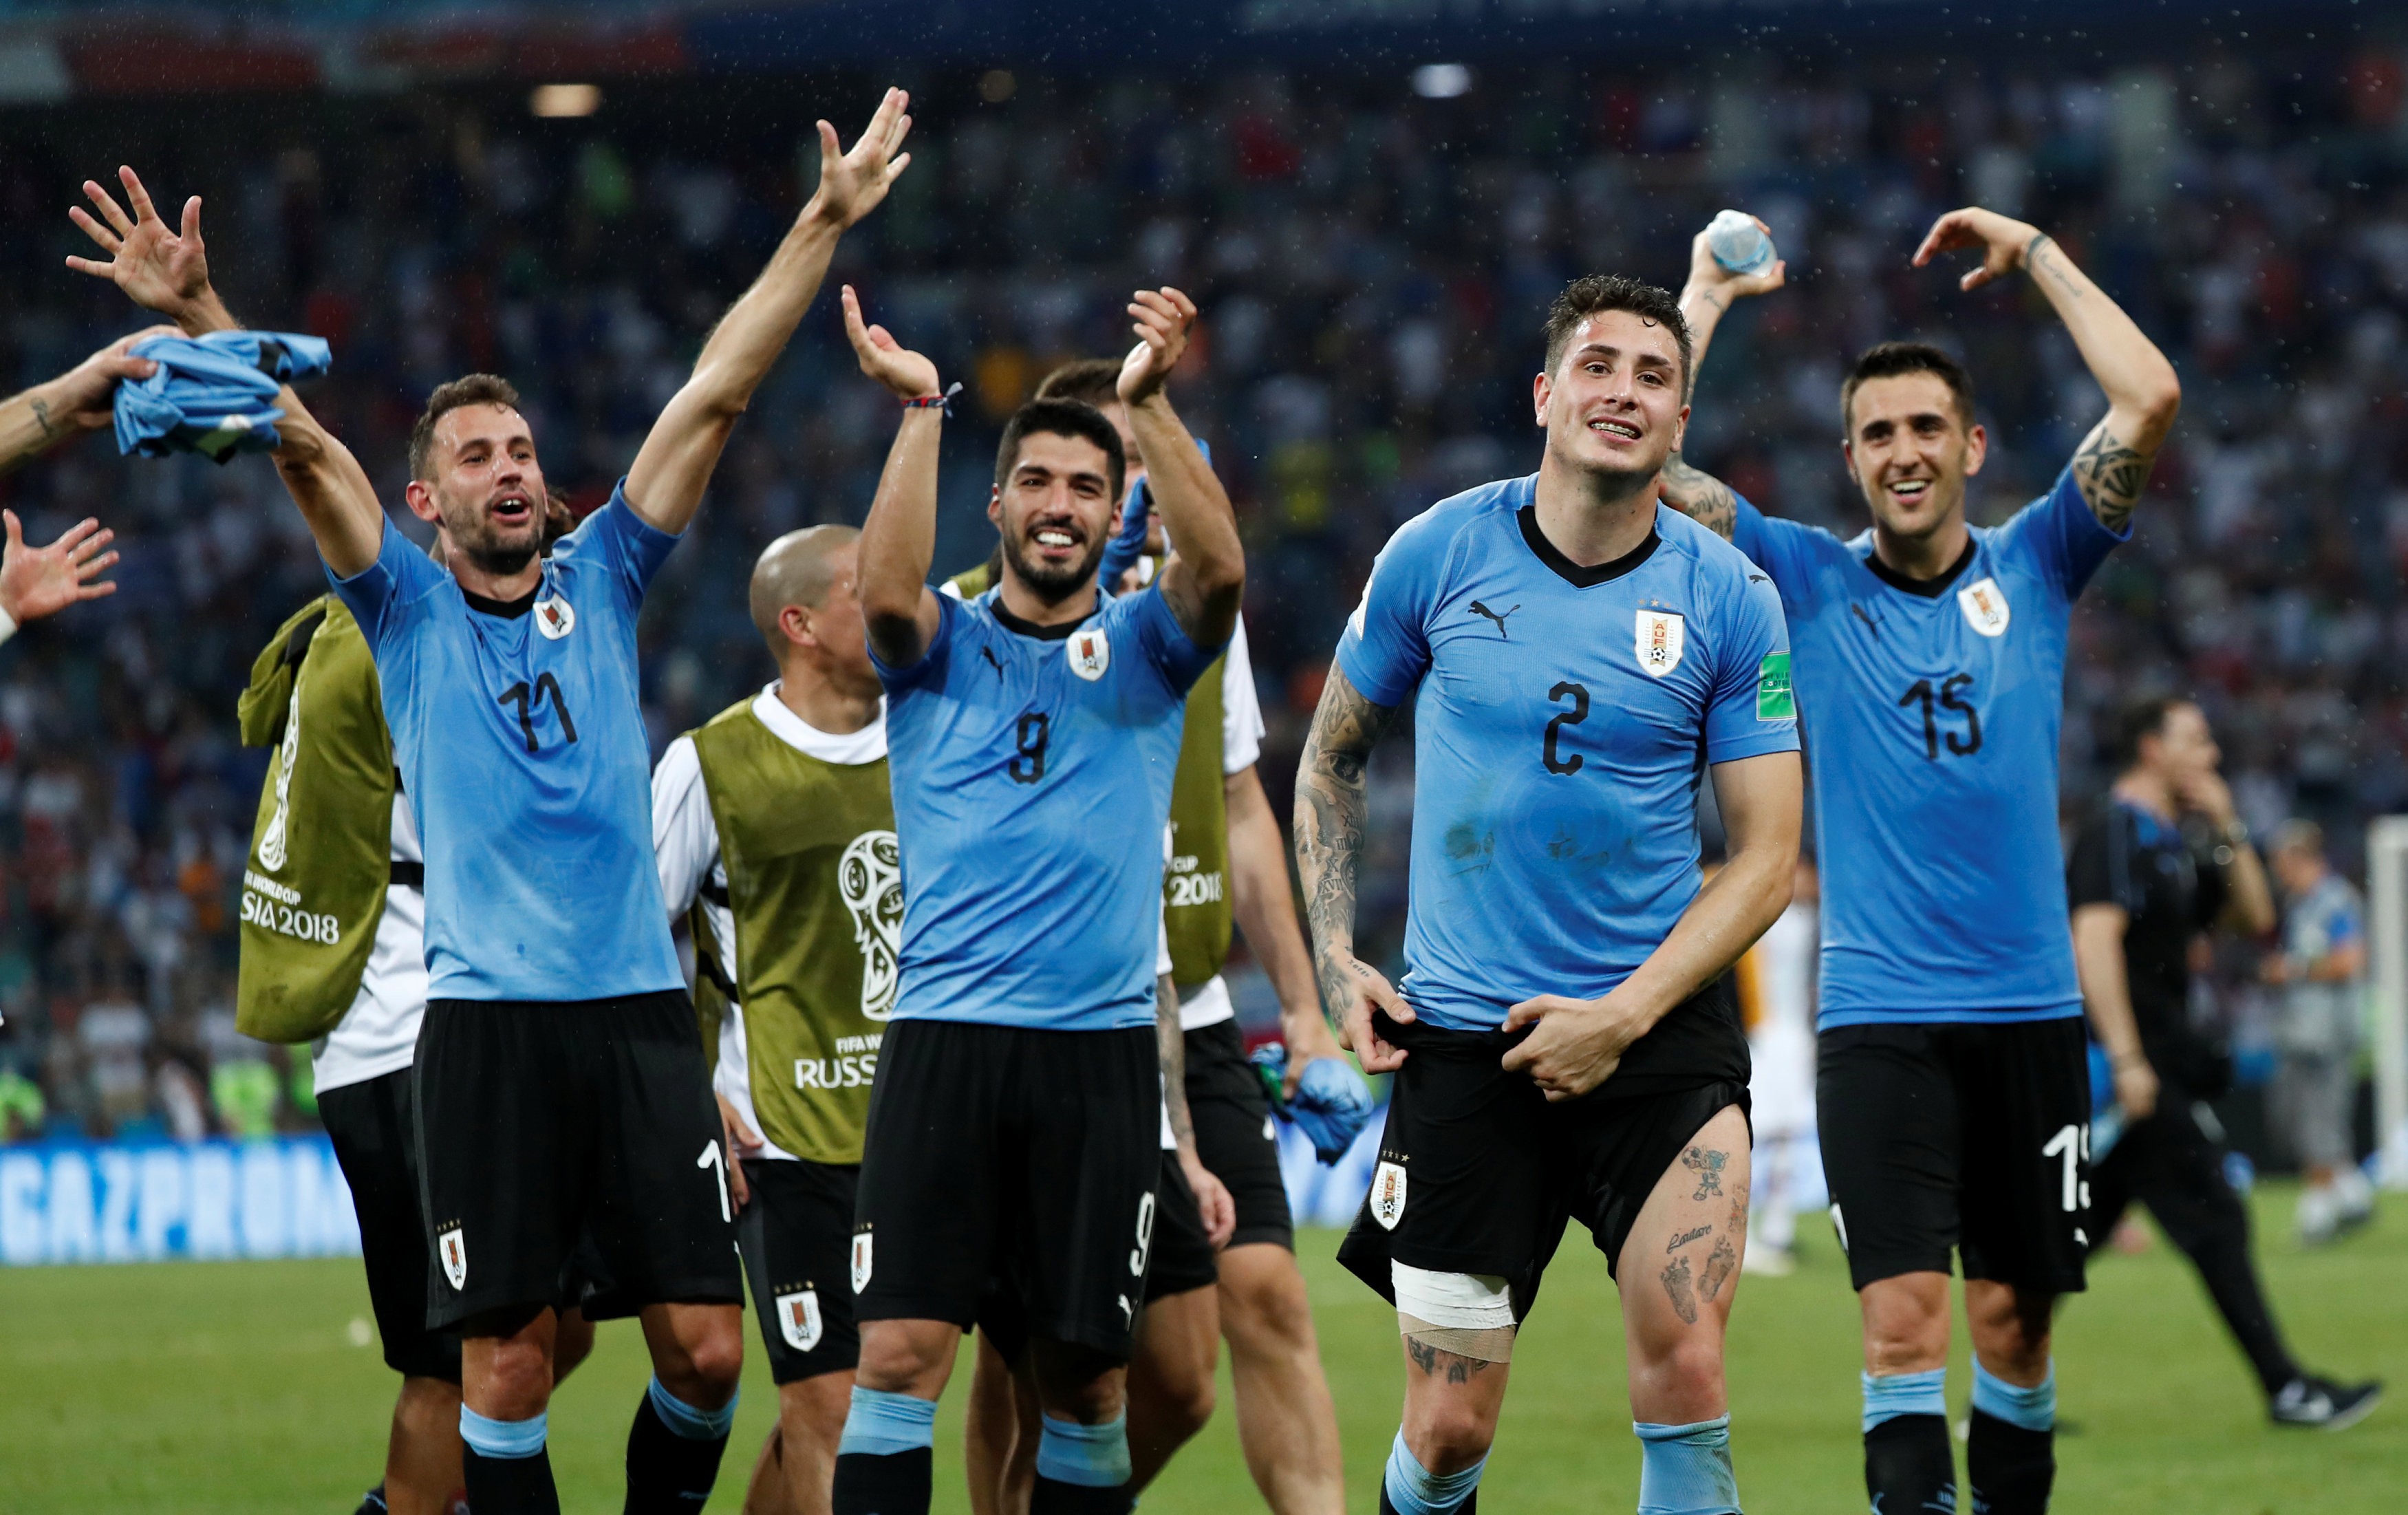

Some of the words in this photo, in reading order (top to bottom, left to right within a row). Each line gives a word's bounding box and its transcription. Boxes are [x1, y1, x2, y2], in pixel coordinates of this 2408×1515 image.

[1654, 623, 1665, 645] AUF
[498, 672, 577, 751] 11
[1543, 681, 1589, 776] 2
[1899, 672, 1984, 760] 15
[1009, 713, 1049, 784] 9
[252, 873, 283, 899] WORLD
[283, 887, 301, 905] CUP
[1169, 871, 1223, 906] 2018
[240, 891, 276, 931] SIA
[279, 906, 339, 945] 2018
[835, 1035, 866, 1053] FIFA
[795, 1054, 878, 1089] RUSS
[1385, 1175, 1395, 1199] AUF
[1129, 1191, 1154, 1278] 9
